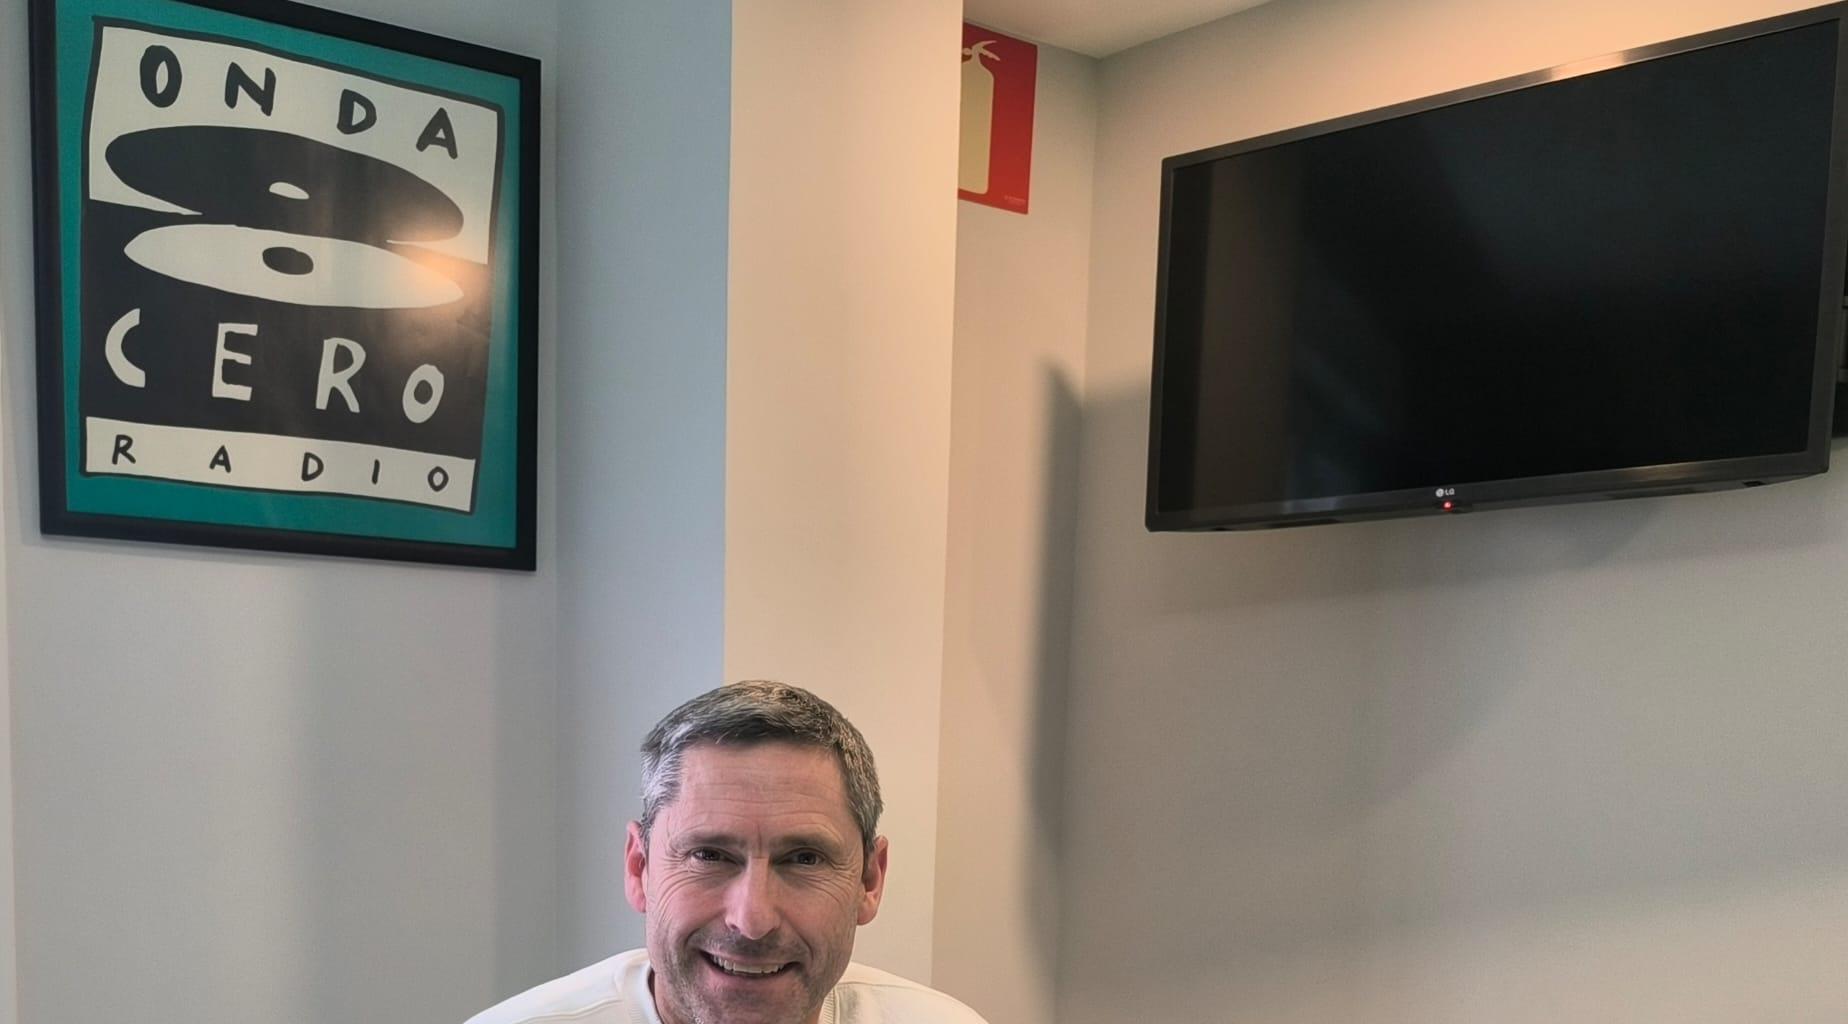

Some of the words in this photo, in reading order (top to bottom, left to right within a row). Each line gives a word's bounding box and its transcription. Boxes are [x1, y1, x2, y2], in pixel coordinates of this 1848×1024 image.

[140, 44, 458, 159] ONDA
[105, 308, 445, 424] CERO
[112, 434, 449, 492] RADIO
